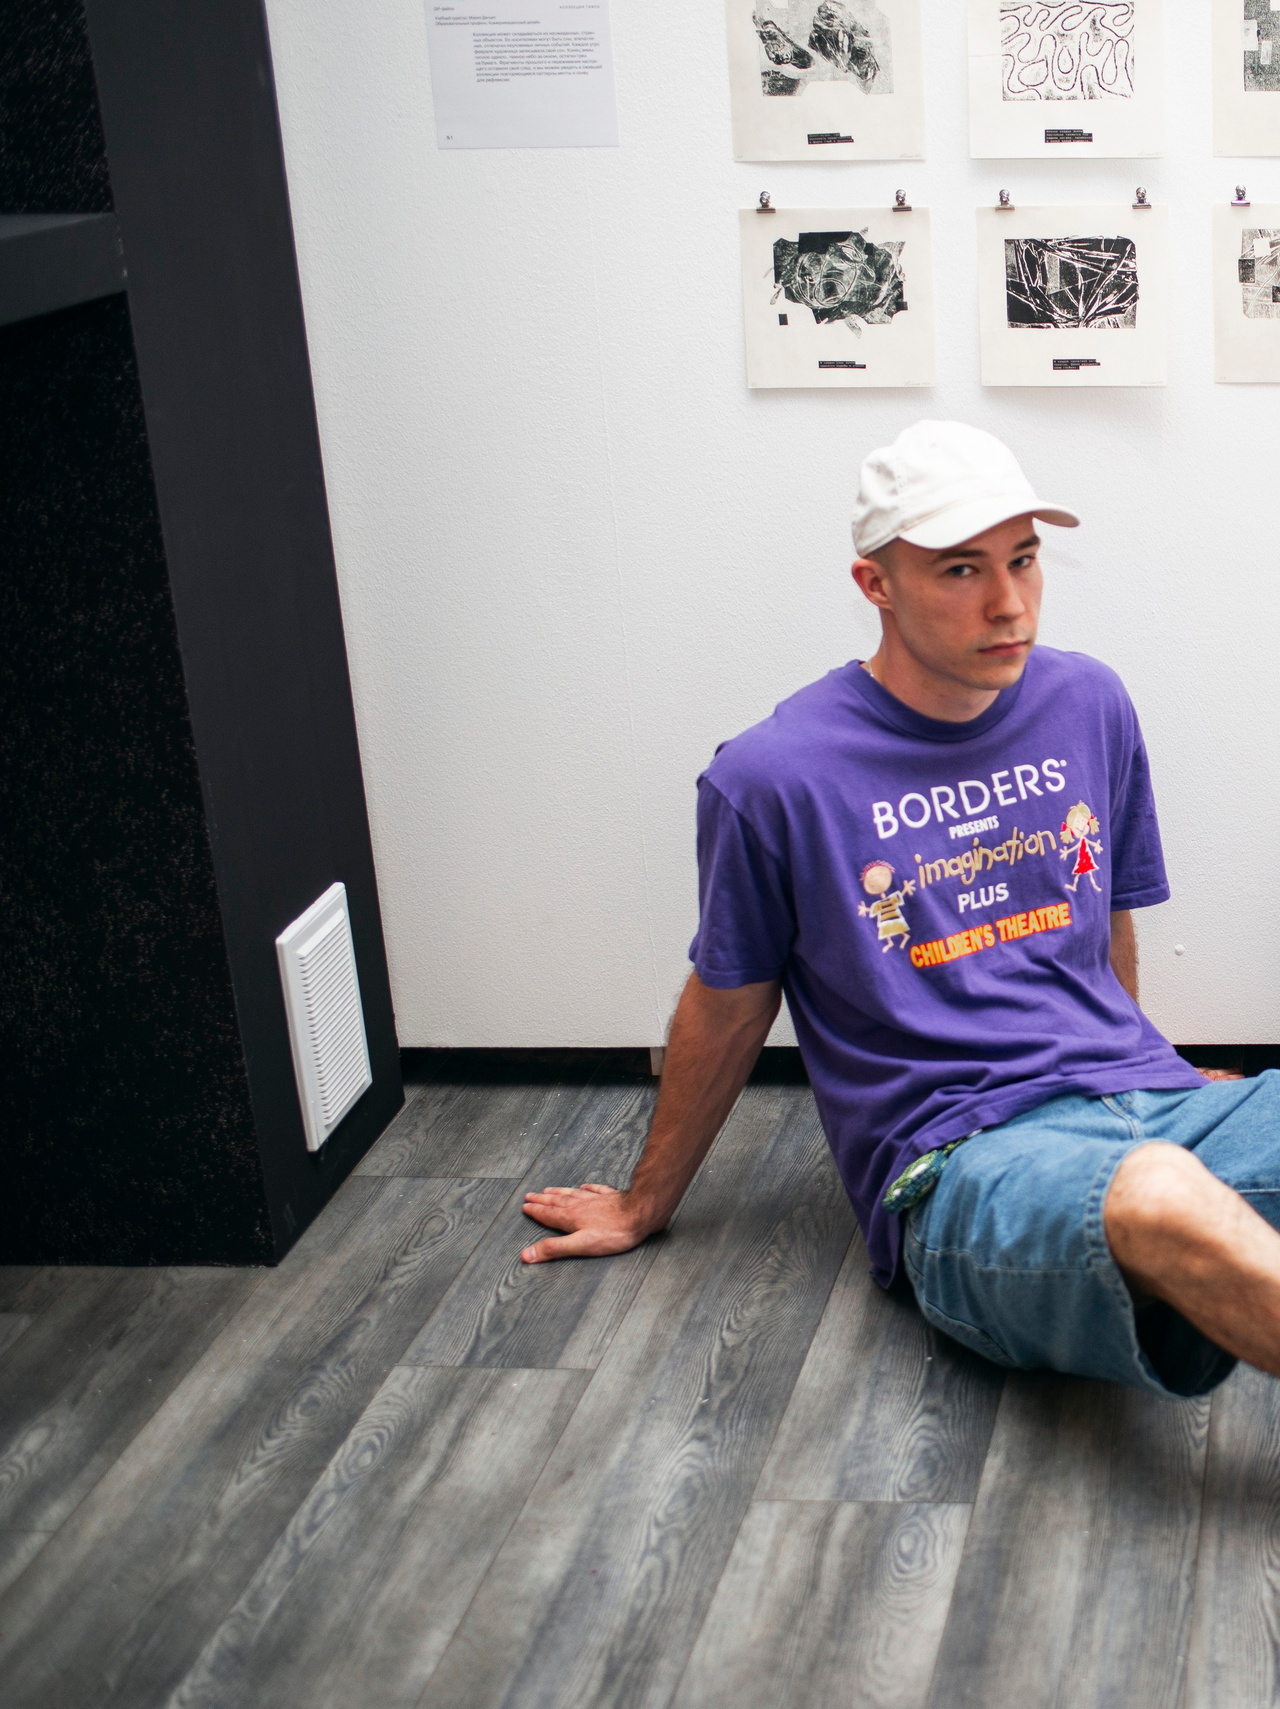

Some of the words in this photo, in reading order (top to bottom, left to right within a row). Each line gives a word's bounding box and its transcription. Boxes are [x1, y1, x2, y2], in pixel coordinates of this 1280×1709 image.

[872, 758, 1066, 840] BORDERS
[948, 815, 1000, 840] PRESENTS
[914, 826, 1057, 889] imagination
[957, 883, 1009, 913] PLUS
[910, 923, 996, 968] CHILDREN'S
[995, 902, 1072, 943] THEATRE
